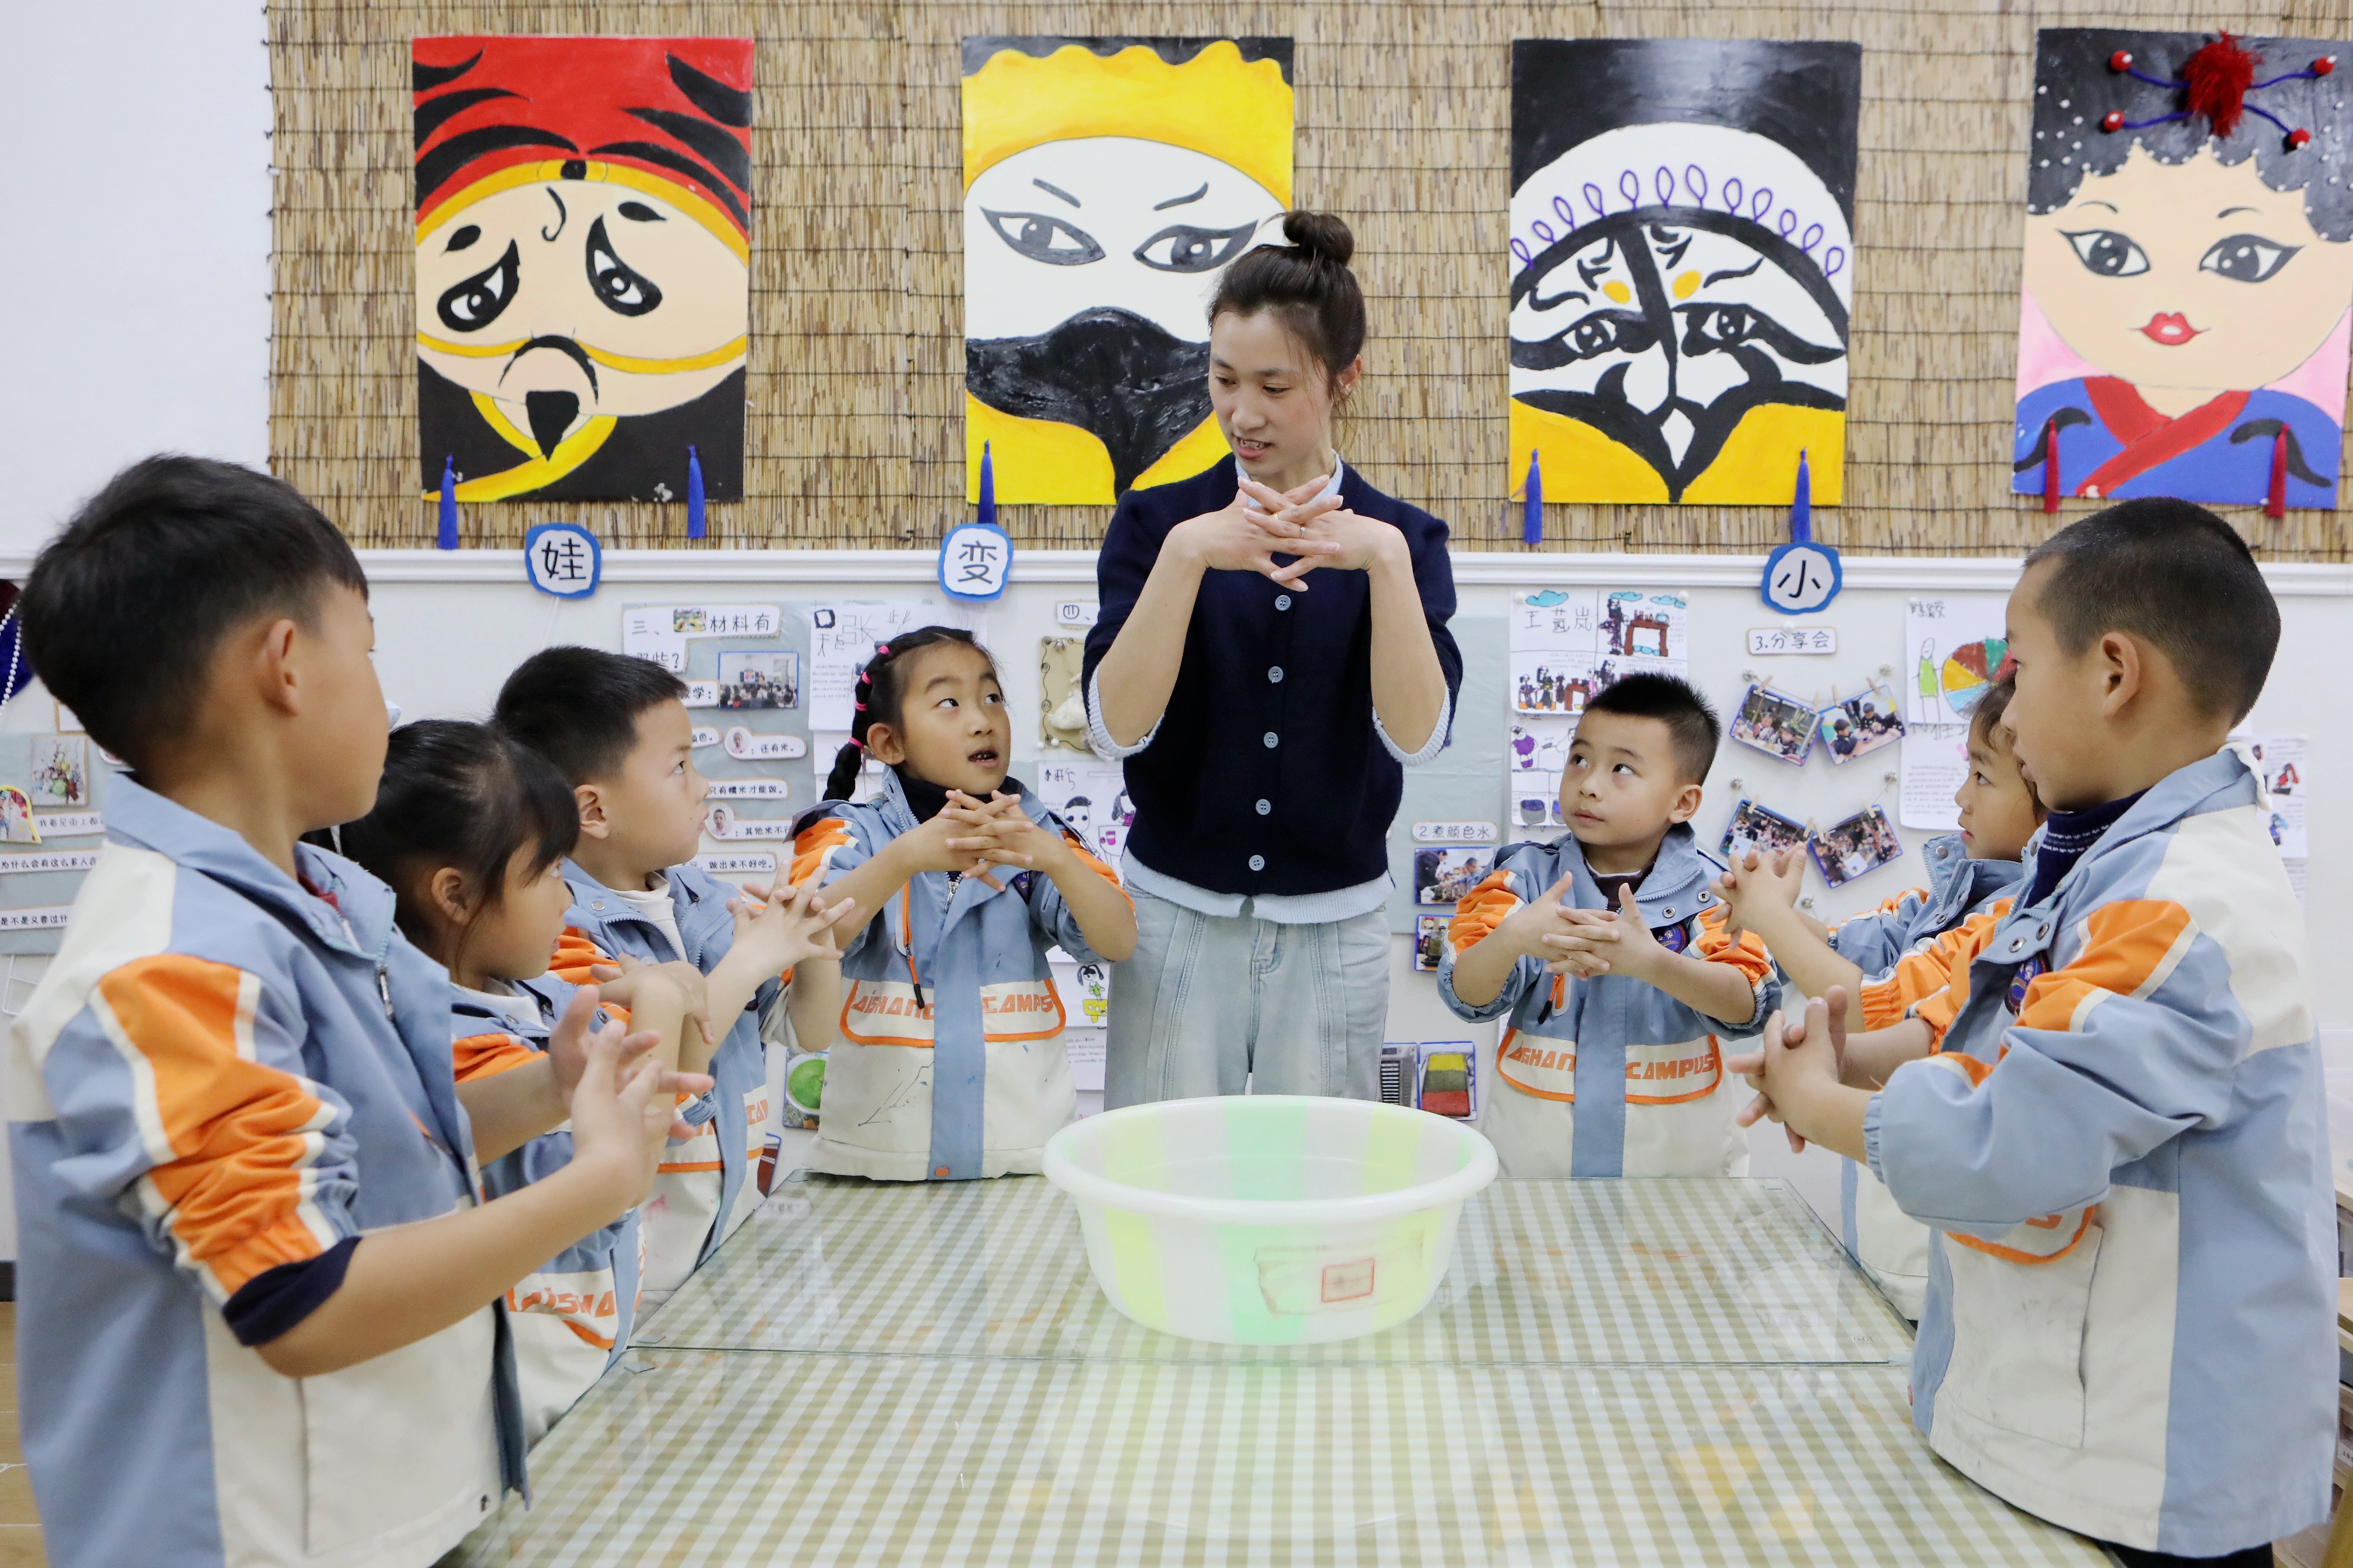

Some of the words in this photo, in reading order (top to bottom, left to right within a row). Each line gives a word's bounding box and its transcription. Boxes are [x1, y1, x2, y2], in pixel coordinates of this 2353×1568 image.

[541, 537, 586, 579] 娃
[958, 540, 998, 585] 变
[1777, 560, 1821, 598] 小
[710, 613, 770, 632] 材料有
[1755, 630, 1830, 651] 3.分享会
[1626, 1053, 1715, 1080] CAMPUS
